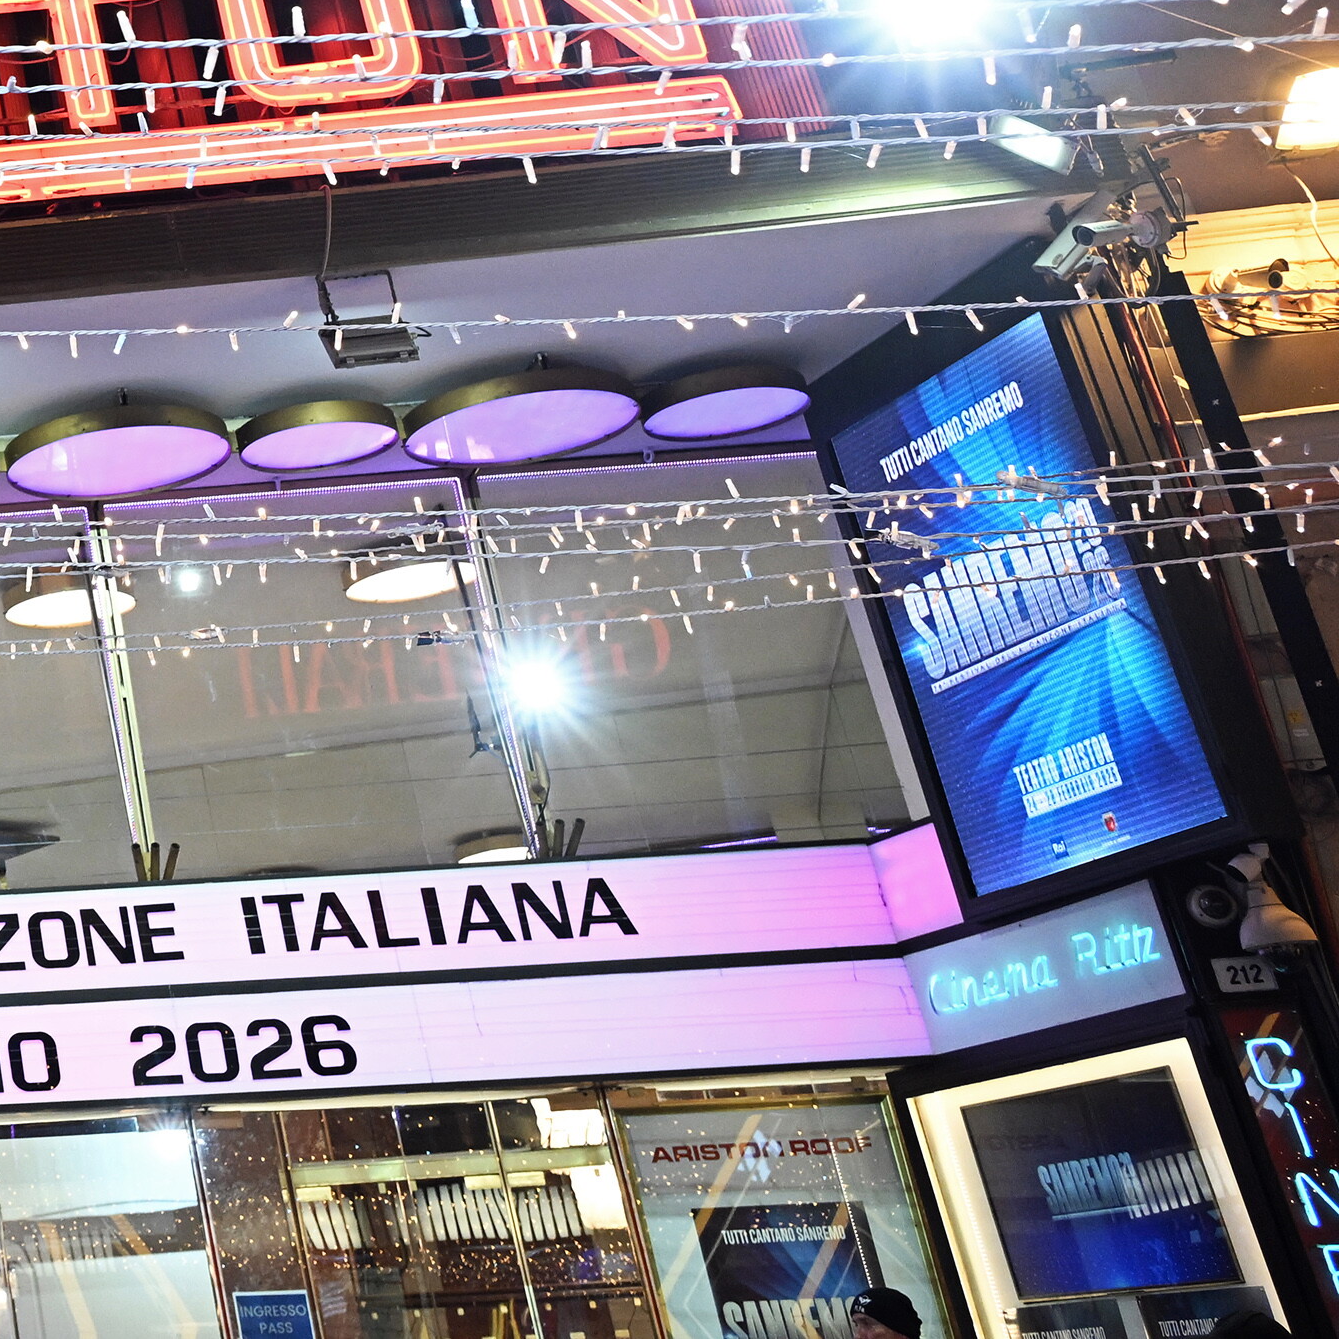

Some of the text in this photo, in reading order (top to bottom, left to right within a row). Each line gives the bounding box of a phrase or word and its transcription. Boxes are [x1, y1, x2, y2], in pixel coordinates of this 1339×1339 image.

[880, 381, 1024, 483] TUTTI CANTANO SANREMO
[903, 512, 1091, 680] SANREMO
[1013, 732, 1115, 795] TEATRO ARISTON
[242, 877, 640, 956] ITALIANA
[928, 923, 1162, 1016] Cinema Ritz
[1226, 964, 1265, 986] 212
[129, 1014, 359, 1087] 2026
[652, 1136, 872, 1164] ARISTON ROOF
[1037, 1153, 1122, 1213] SANREMO
[721, 1225, 846, 1246] TUTTI CANTANO SANREMO
[239, 1303, 307, 1334] INGRESSO PASS
[722, 1296, 858, 1339] SANREM
[1159, 1320, 1180, 1337] TUTTI
